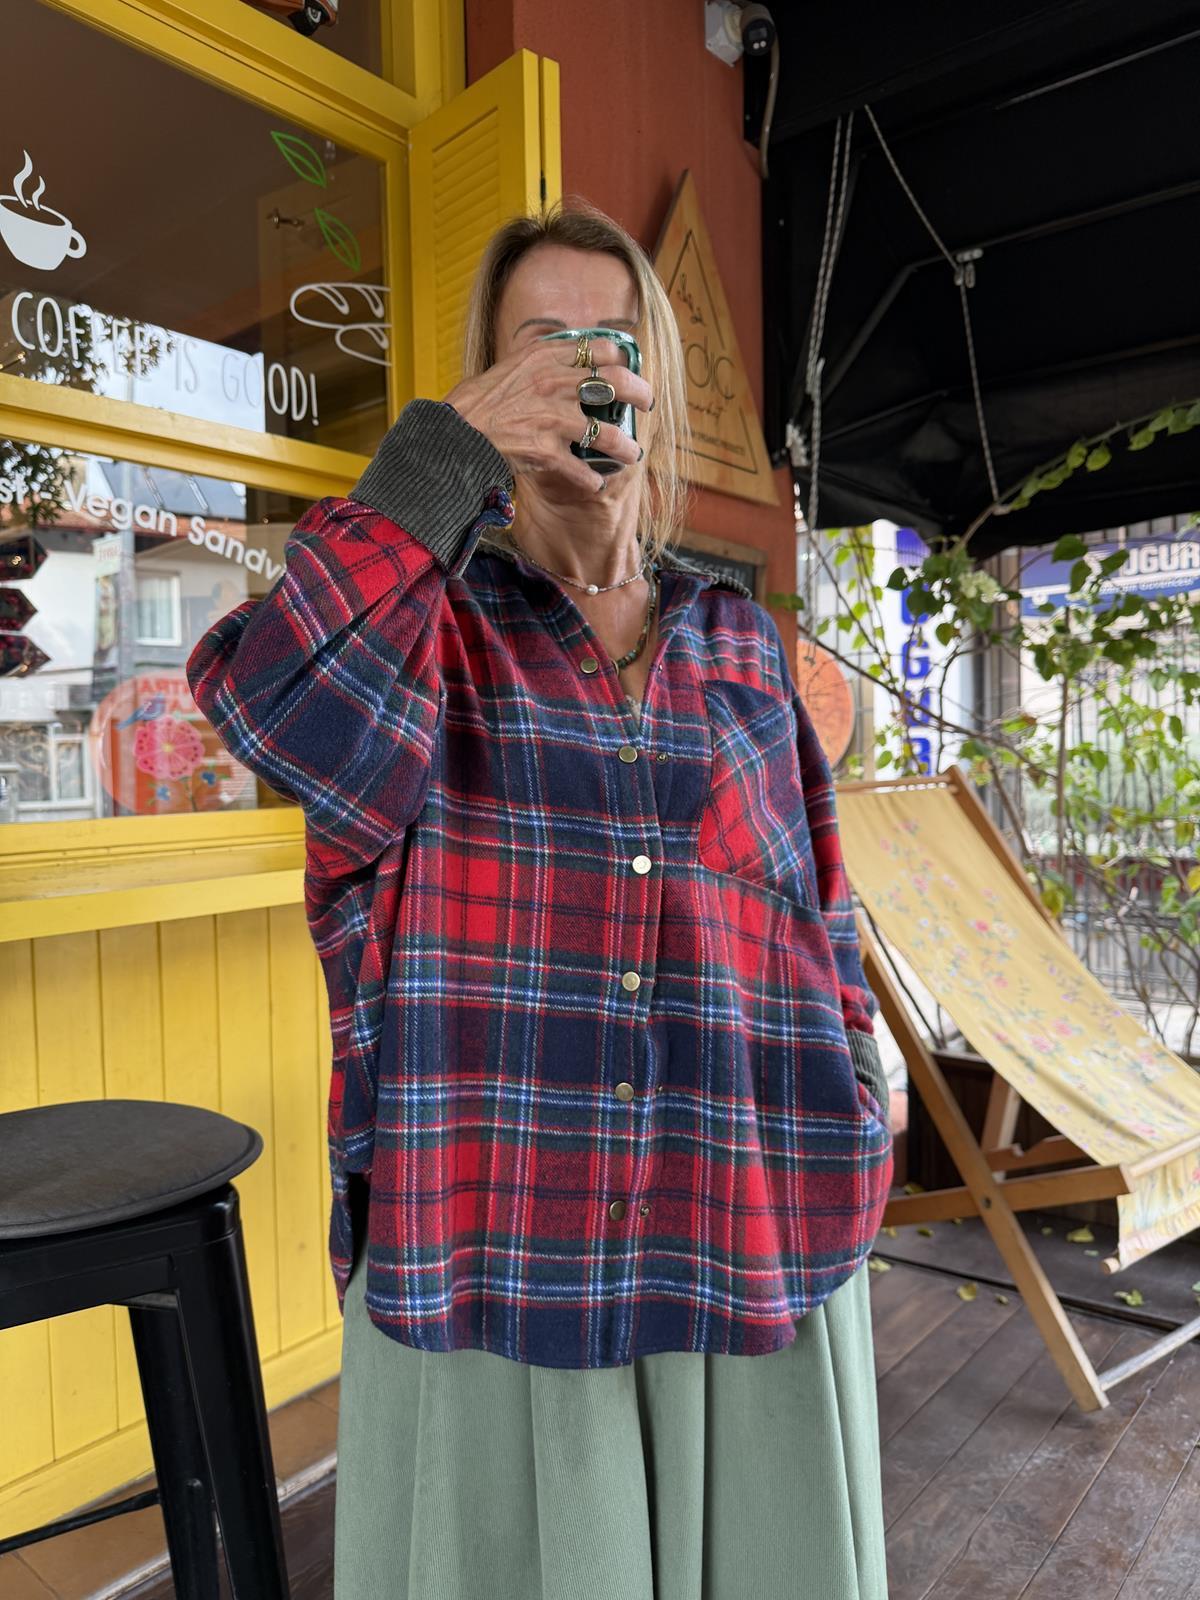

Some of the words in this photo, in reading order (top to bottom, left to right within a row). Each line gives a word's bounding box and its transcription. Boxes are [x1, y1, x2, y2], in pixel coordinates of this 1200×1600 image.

[10, 291, 152, 382] COFFEE
[173, 335, 198, 394] IS
[222, 351, 319, 426] GOOD!
[63, 480, 177, 537] Vegan
